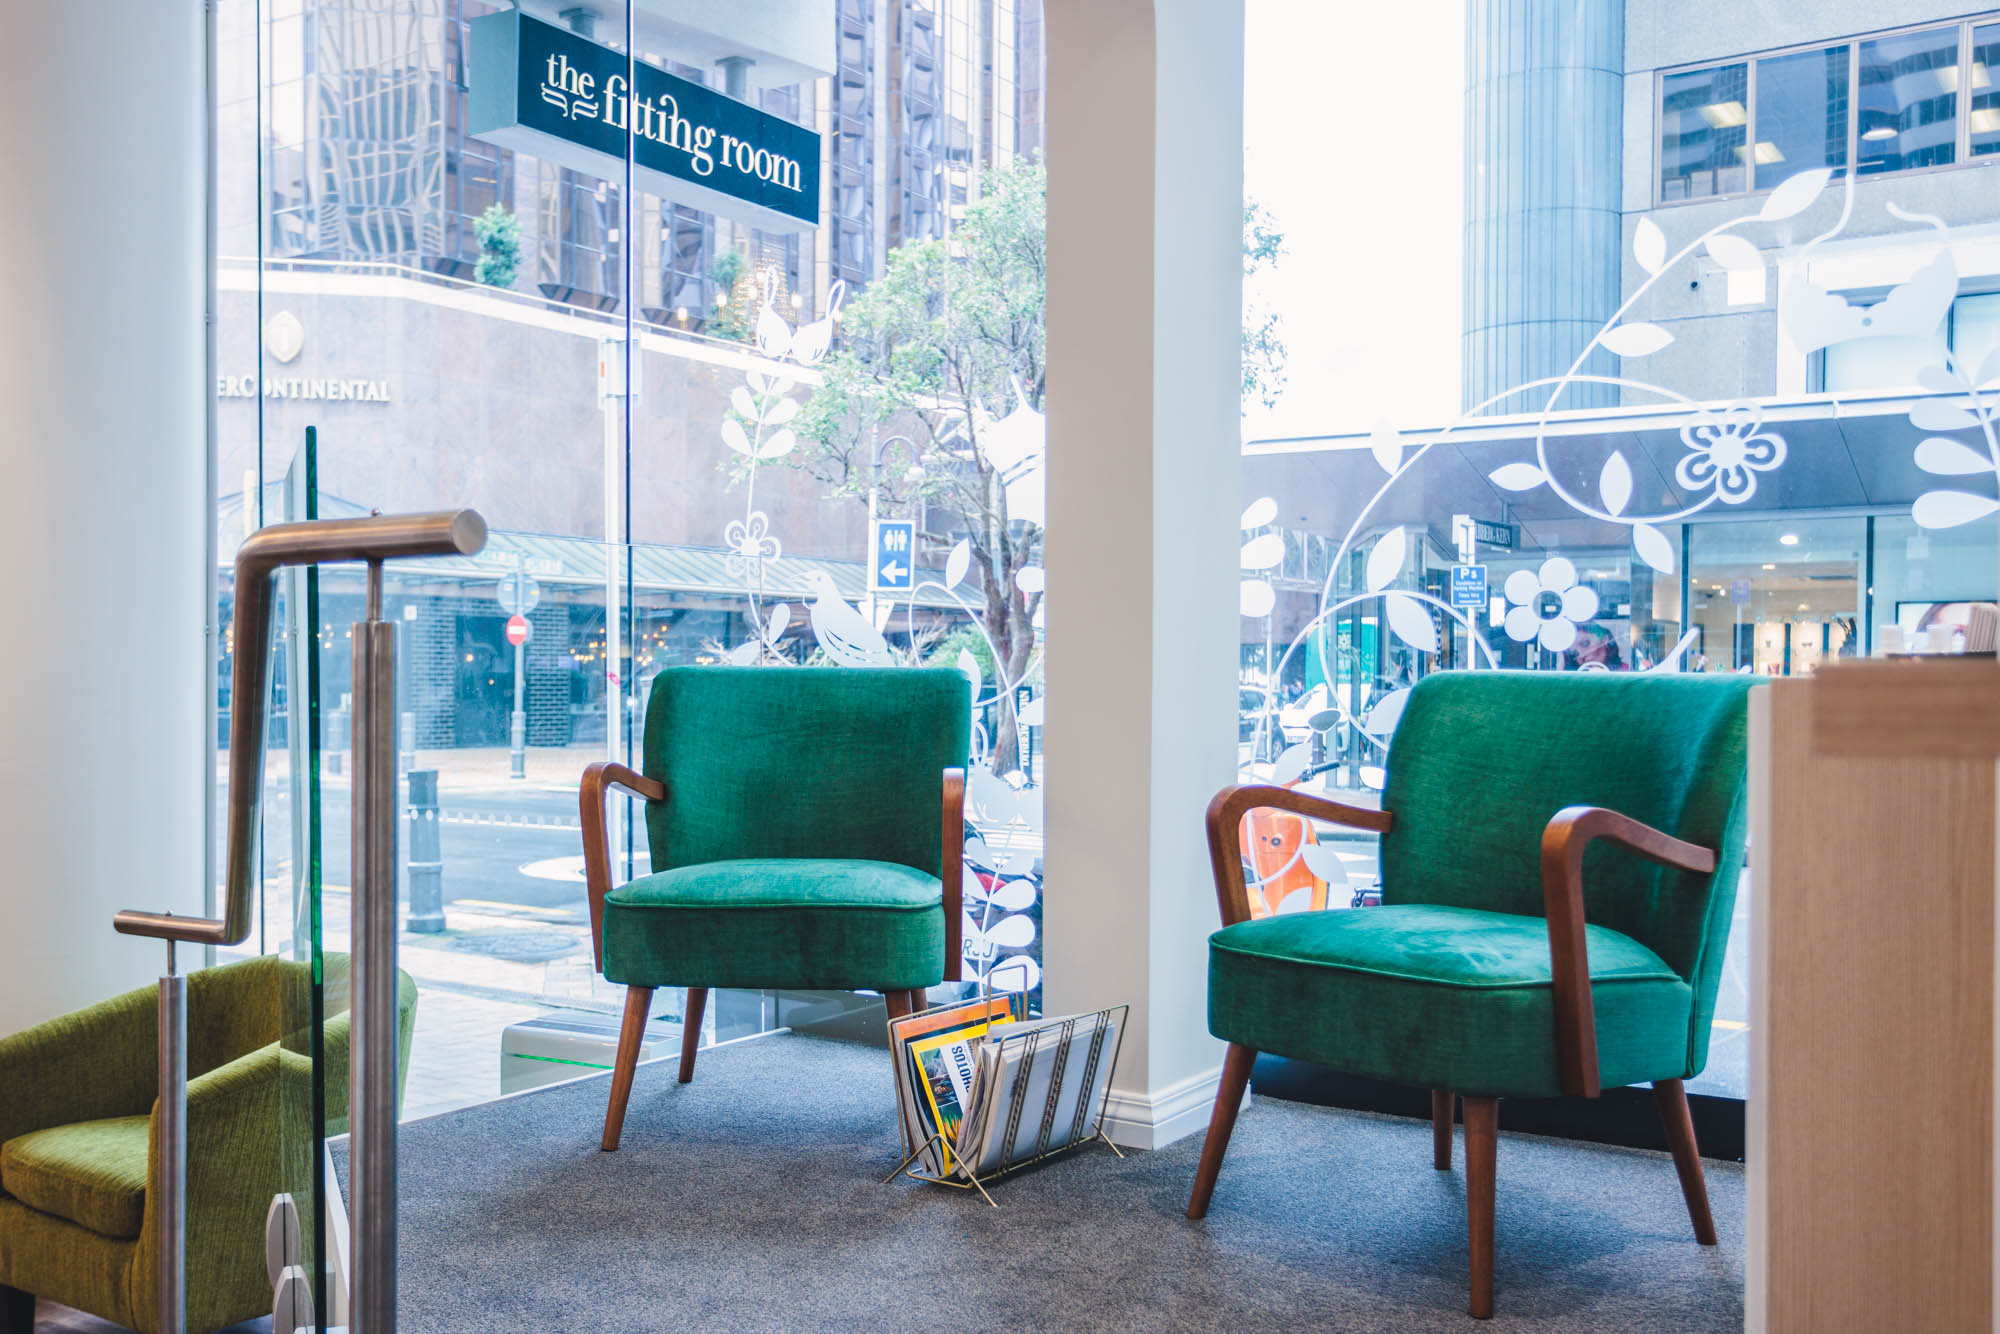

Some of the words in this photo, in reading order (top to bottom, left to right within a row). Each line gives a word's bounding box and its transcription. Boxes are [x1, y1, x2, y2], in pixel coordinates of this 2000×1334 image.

[546, 53, 595, 100] the
[602, 74, 717, 177] fitting
[719, 133, 803, 193] room
